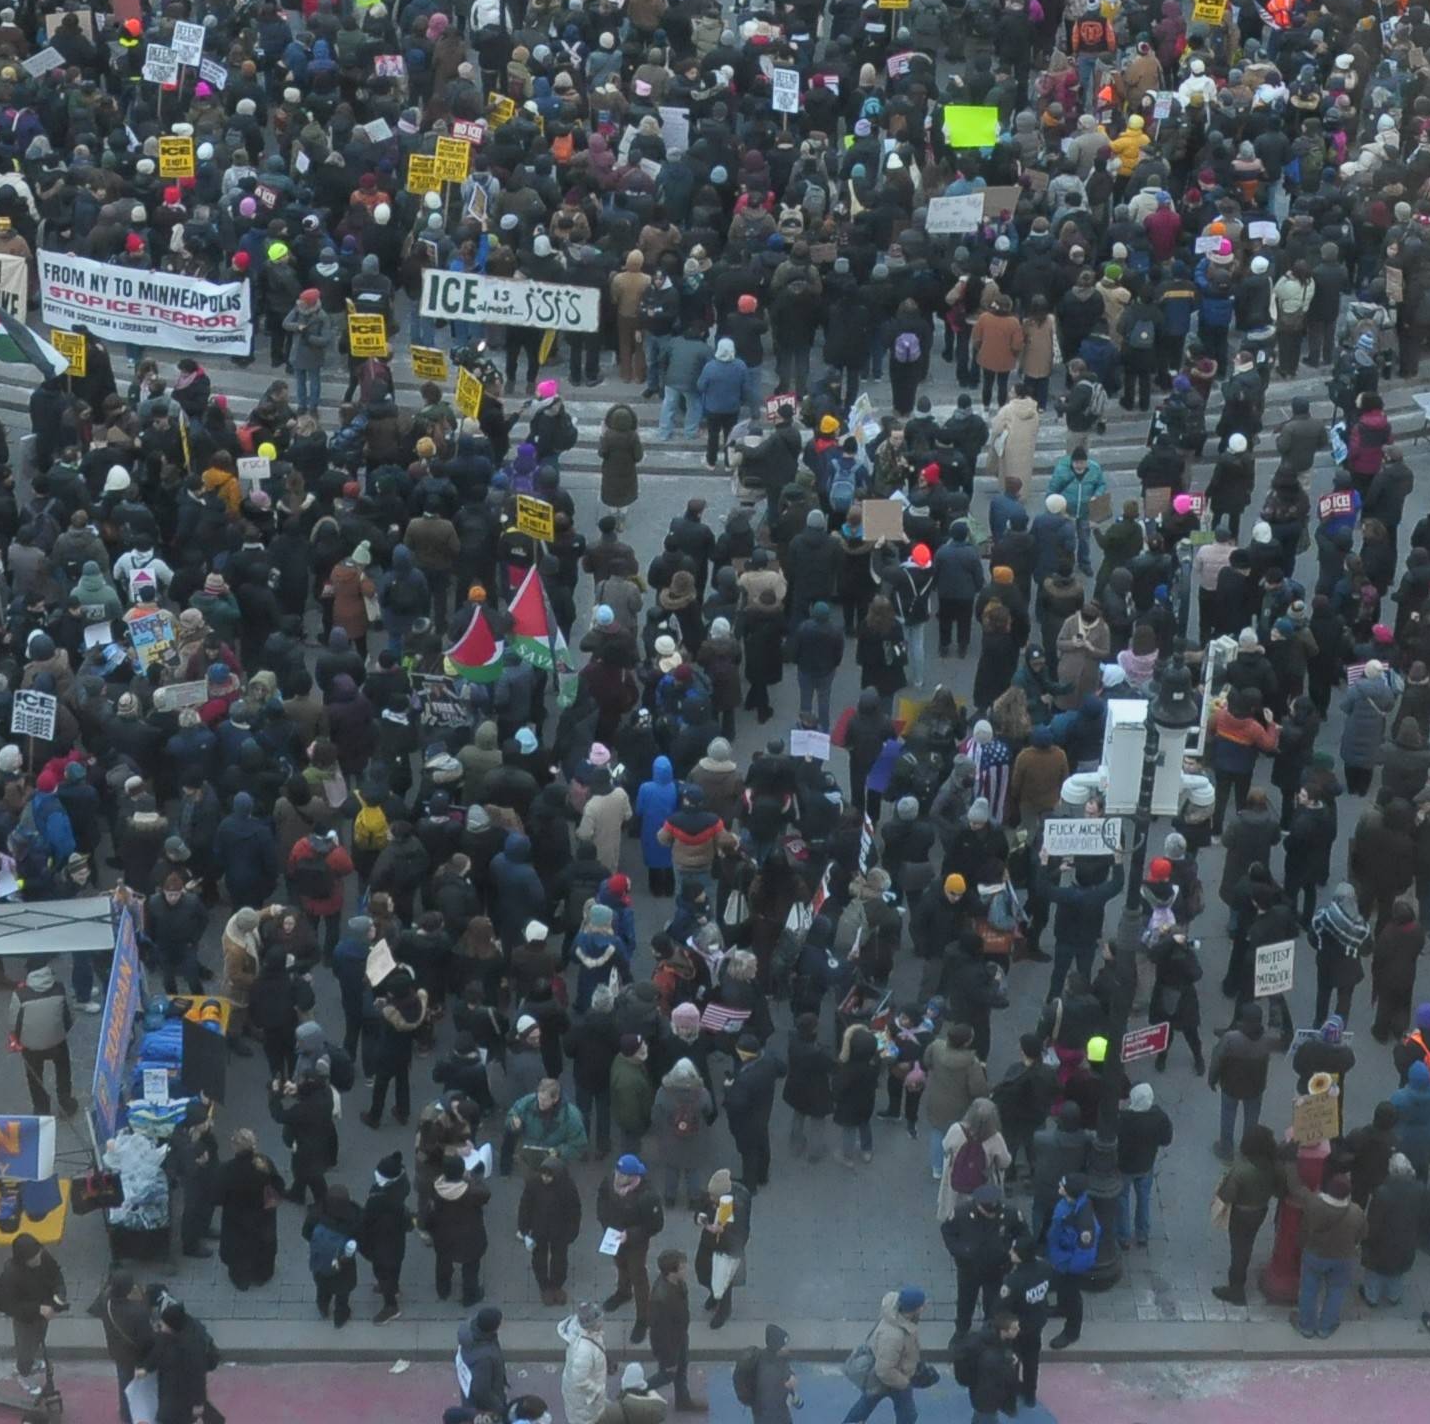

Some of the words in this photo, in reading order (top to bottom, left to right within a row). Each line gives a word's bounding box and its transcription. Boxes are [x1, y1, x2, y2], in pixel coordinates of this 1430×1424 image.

[454, 122, 467, 134] NO
[161, 147, 192, 156] ICE
[44, 263, 85, 288] FROM
[90, 274, 108, 294] NY
[114, 277, 133, 297] TO
[138, 281, 241, 312] MINNEAPOLIS
[428, 274, 478, 315] ICE
[49, 285, 103, 306] STOP
[106, 299, 143, 315] ICE
[145, 304, 237, 328] TERROR
[44, 303, 62, 315] PARTY
[119, 321, 157, 334] LIBERATION
[351, 325, 382, 334] ICE
[414, 354, 445, 366] ICE
[519, 504, 553, 520] ICE
[1320, 497, 1332, 514] NO
[1333, 494, 1351, 509] ICE!
[16, 692, 55, 711] ICE
[1049, 823, 1078, 835] FUCK
[1079, 823, 1117, 835] MICHEL
[1258, 947, 1291, 965] PROTEST
[1026, 1280, 1049, 1304] NYPD
